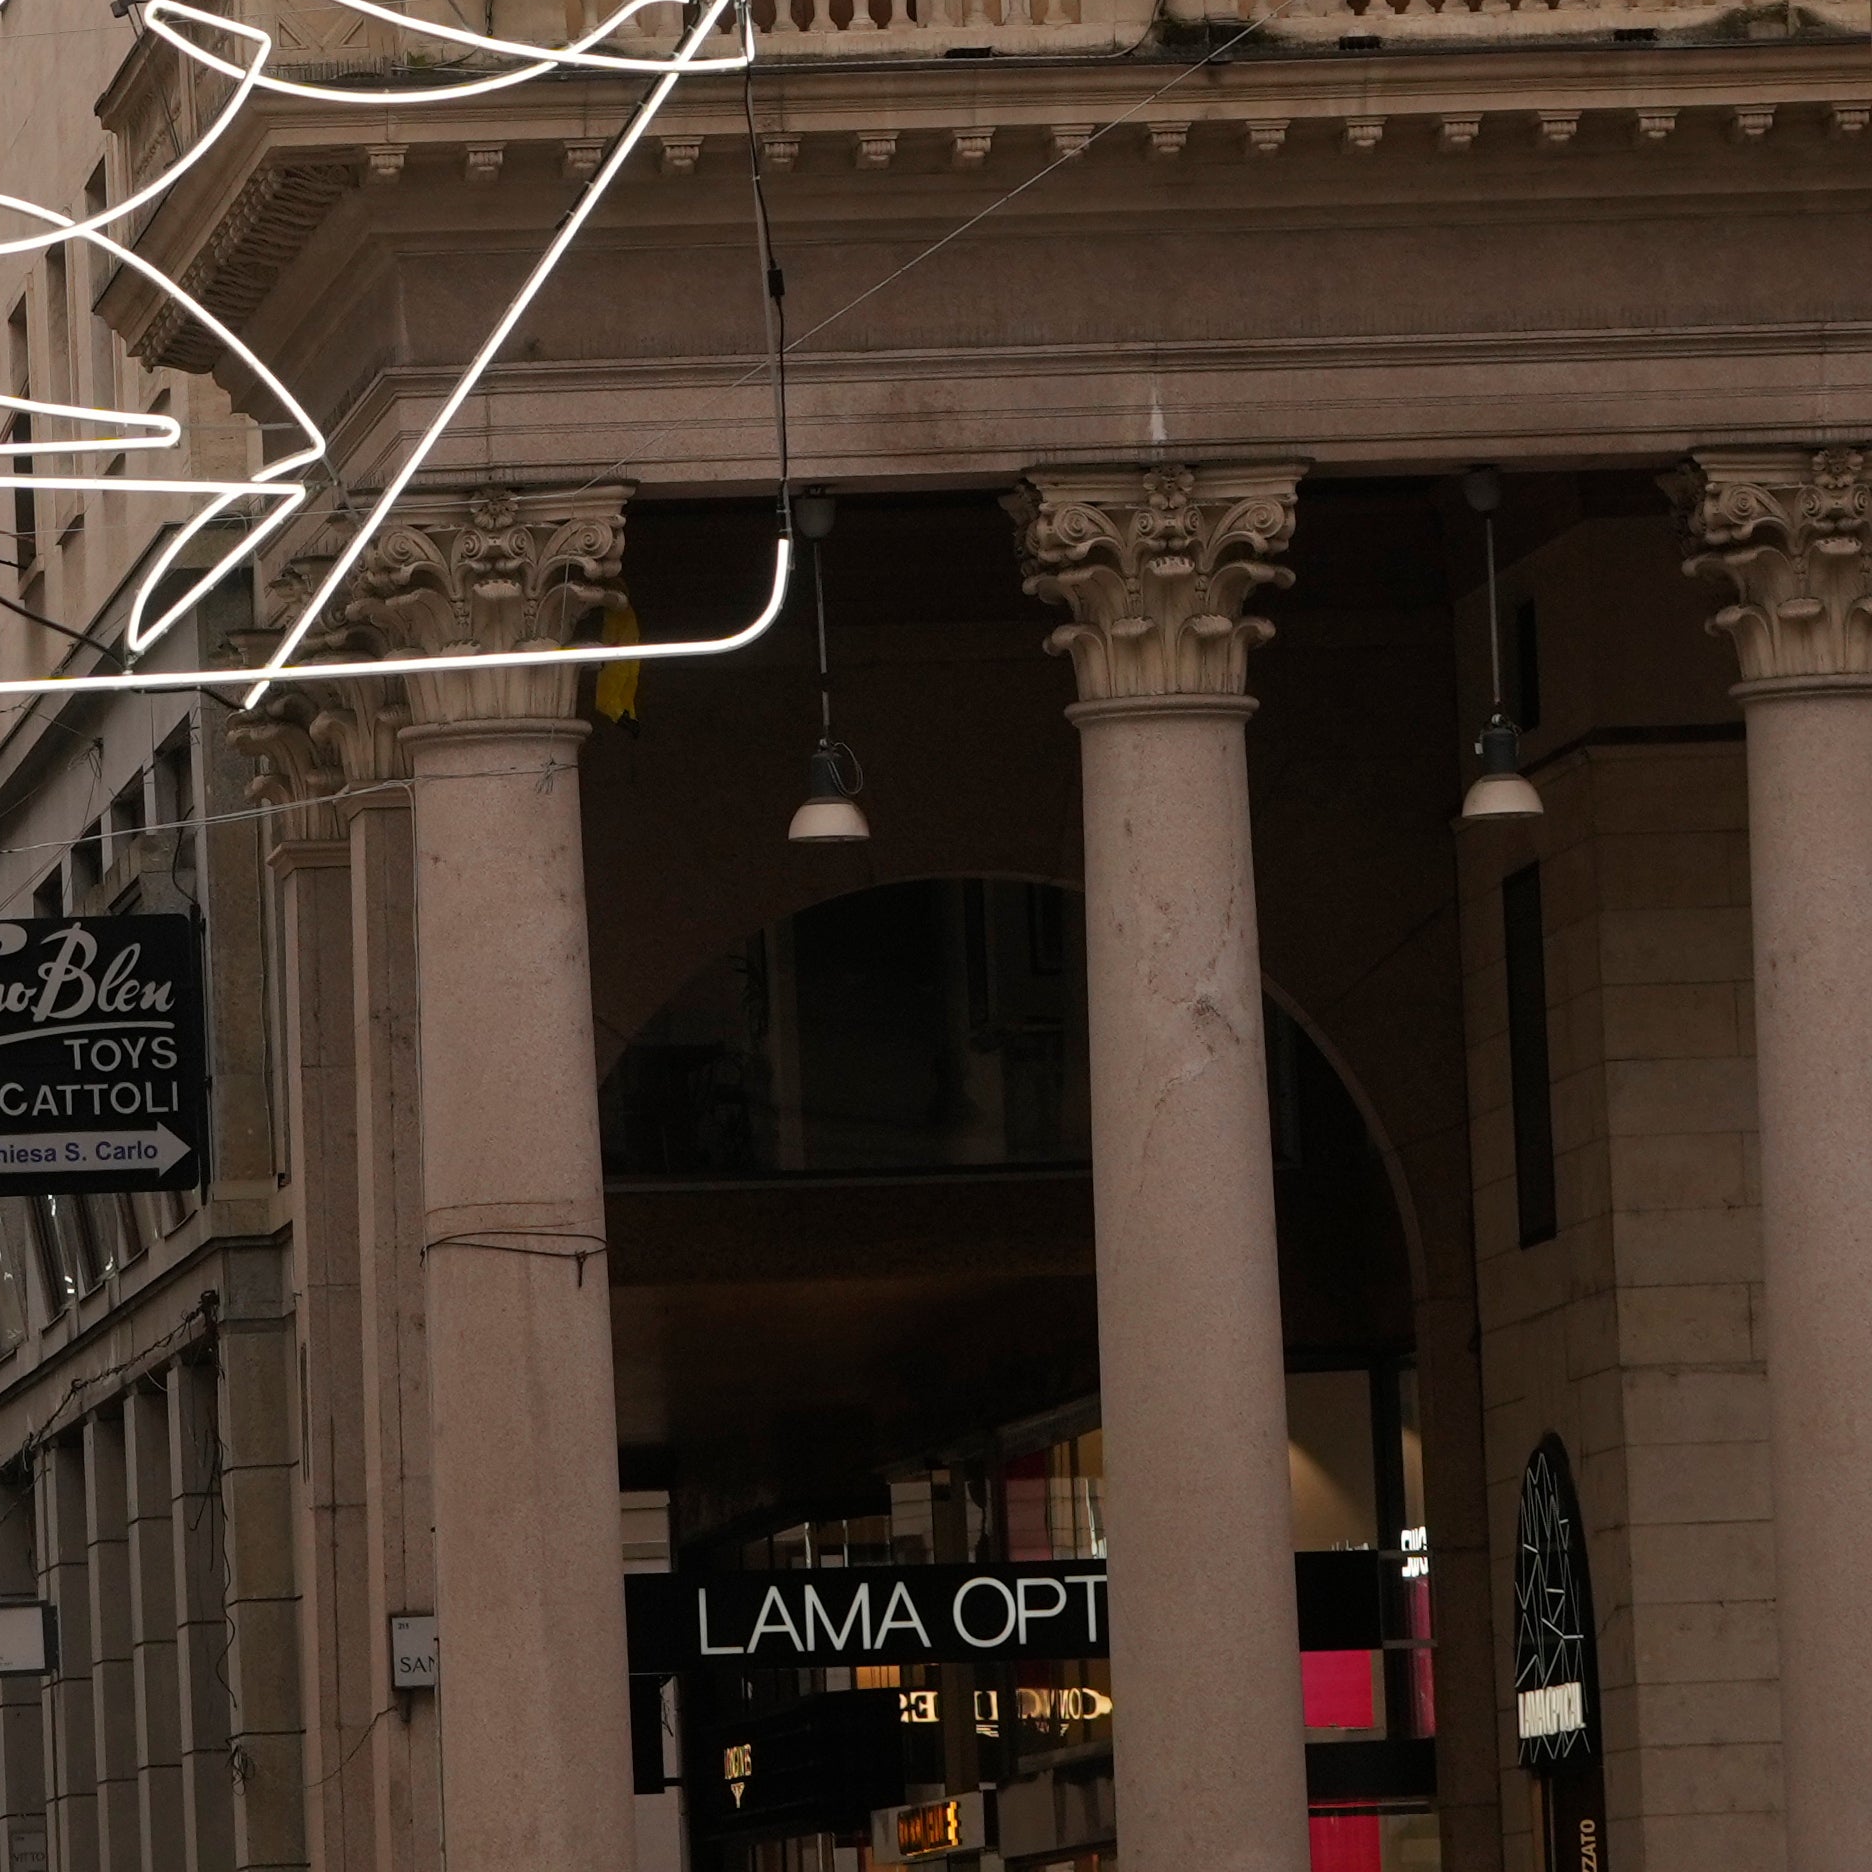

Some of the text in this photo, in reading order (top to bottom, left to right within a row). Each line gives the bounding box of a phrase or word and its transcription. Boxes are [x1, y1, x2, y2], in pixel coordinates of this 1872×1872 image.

[64, 1036, 178, 1072] TOYS
[64, 1142, 88, 1162] S.
[95, 1140, 159, 1162] Carlo
[697, 1580, 933, 1655] LAMA
